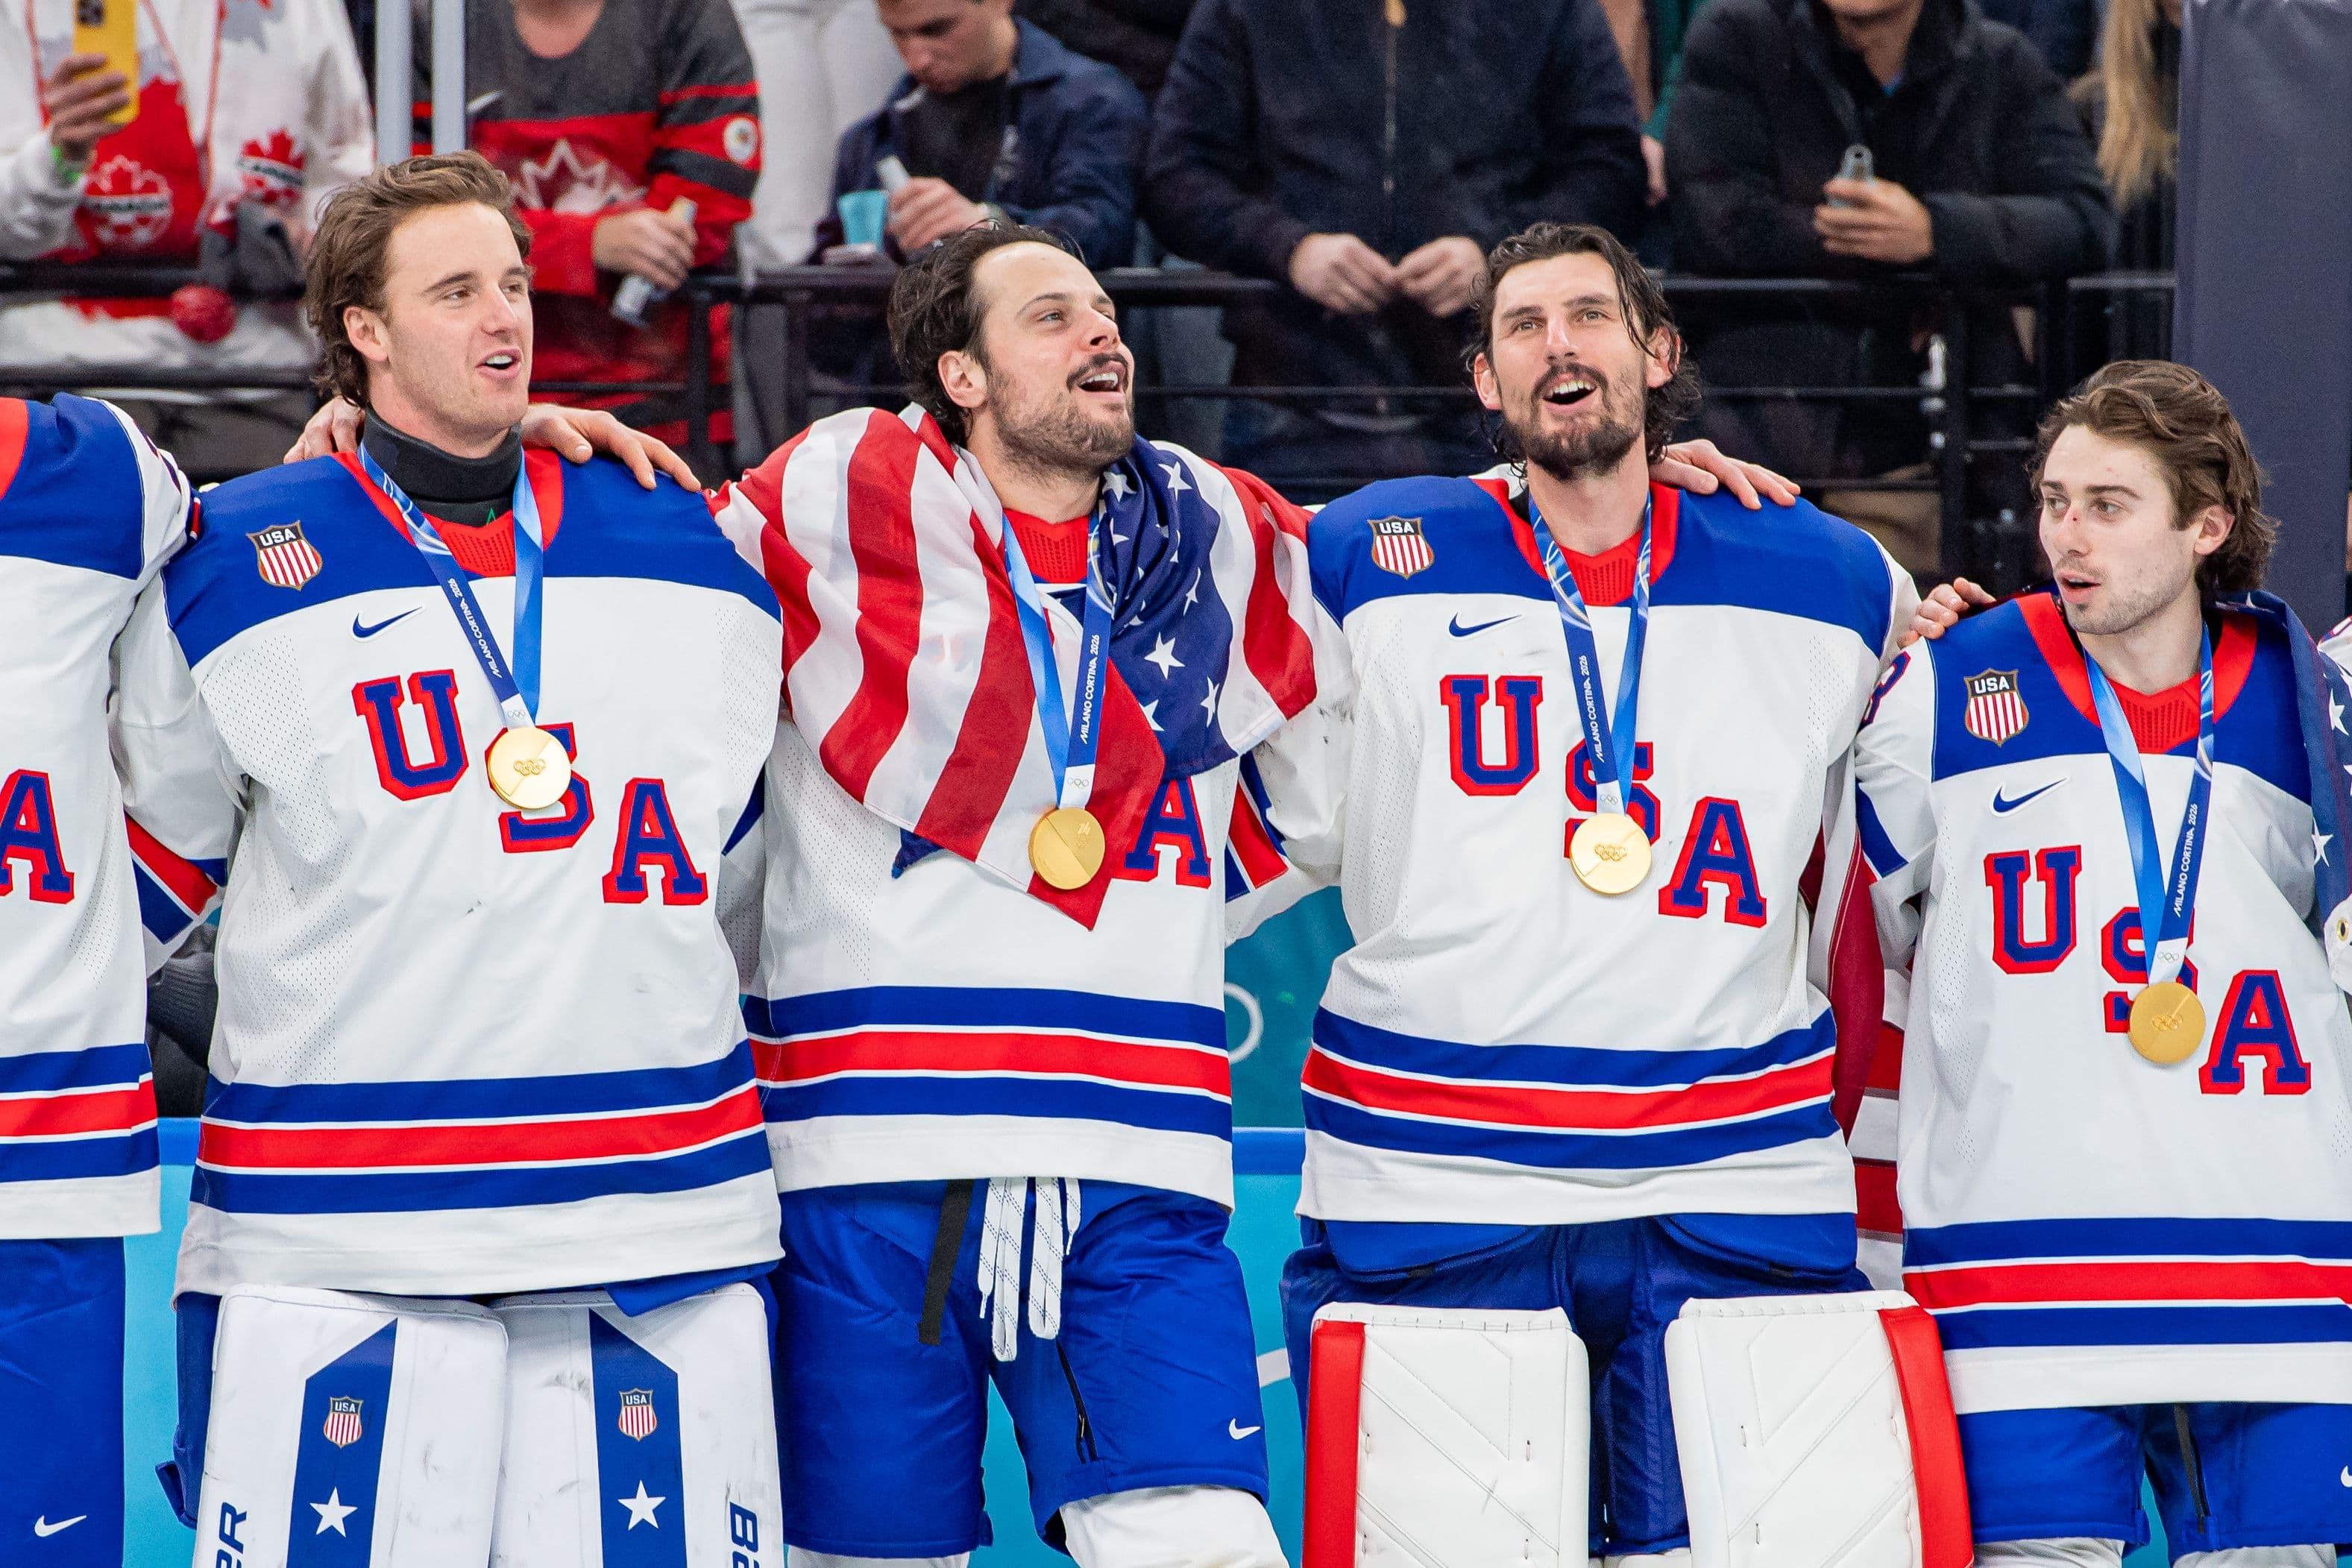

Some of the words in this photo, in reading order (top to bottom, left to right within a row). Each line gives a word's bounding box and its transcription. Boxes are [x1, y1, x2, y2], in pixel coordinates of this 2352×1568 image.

[259, 528, 297, 547] USA
[1379, 521, 1415, 534] USA
[447, 578, 463, 598] 2026
[460, 598, 482, 639] CORTINA
[1090, 634, 1100, 655] 2026
[478, 639, 503, 678] MILANO
[1579, 655, 1590, 676] 2026
[1084, 657, 1098, 700] CORTINA
[1974, 676, 2010, 694] USA
[1583, 677, 1597, 720] CORTINA
[1080, 701, 1092, 745] MILANO
[1590, 721, 1605, 763] MILANO
[2188, 803, 2198, 825] 2026
[2180, 827, 2195, 872] CORTINA
[2173, 873, 2188, 919] MILANO
[334, 1401, 356, 1413] USA
[626, 1394, 647, 1405] USA
